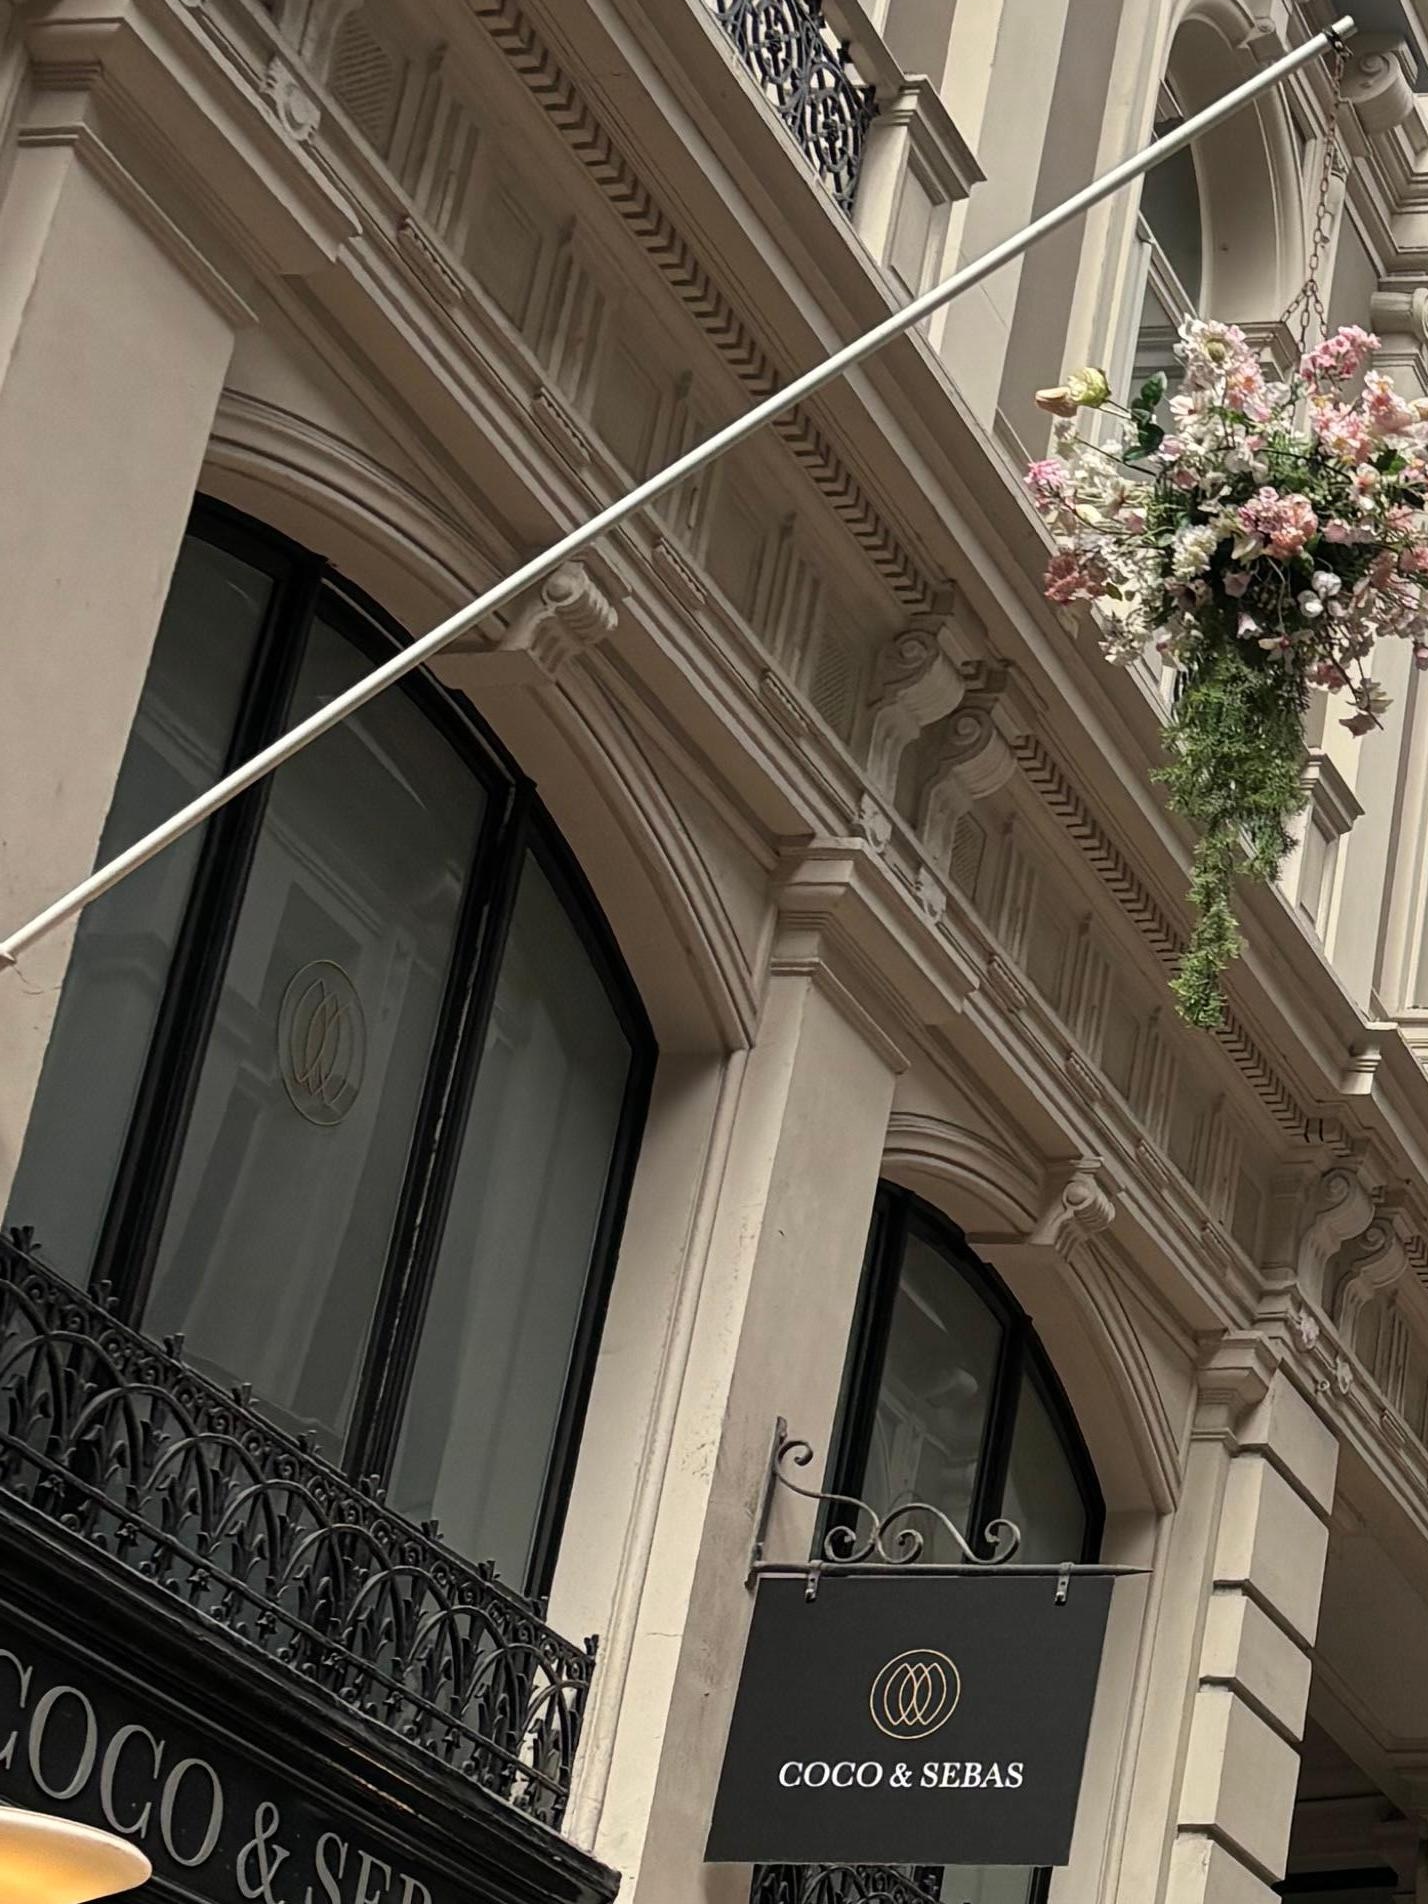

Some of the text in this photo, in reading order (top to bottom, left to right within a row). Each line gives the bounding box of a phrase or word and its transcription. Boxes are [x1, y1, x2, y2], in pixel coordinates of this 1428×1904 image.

[778, 1761, 1025, 1788] COCO & SEBAS
